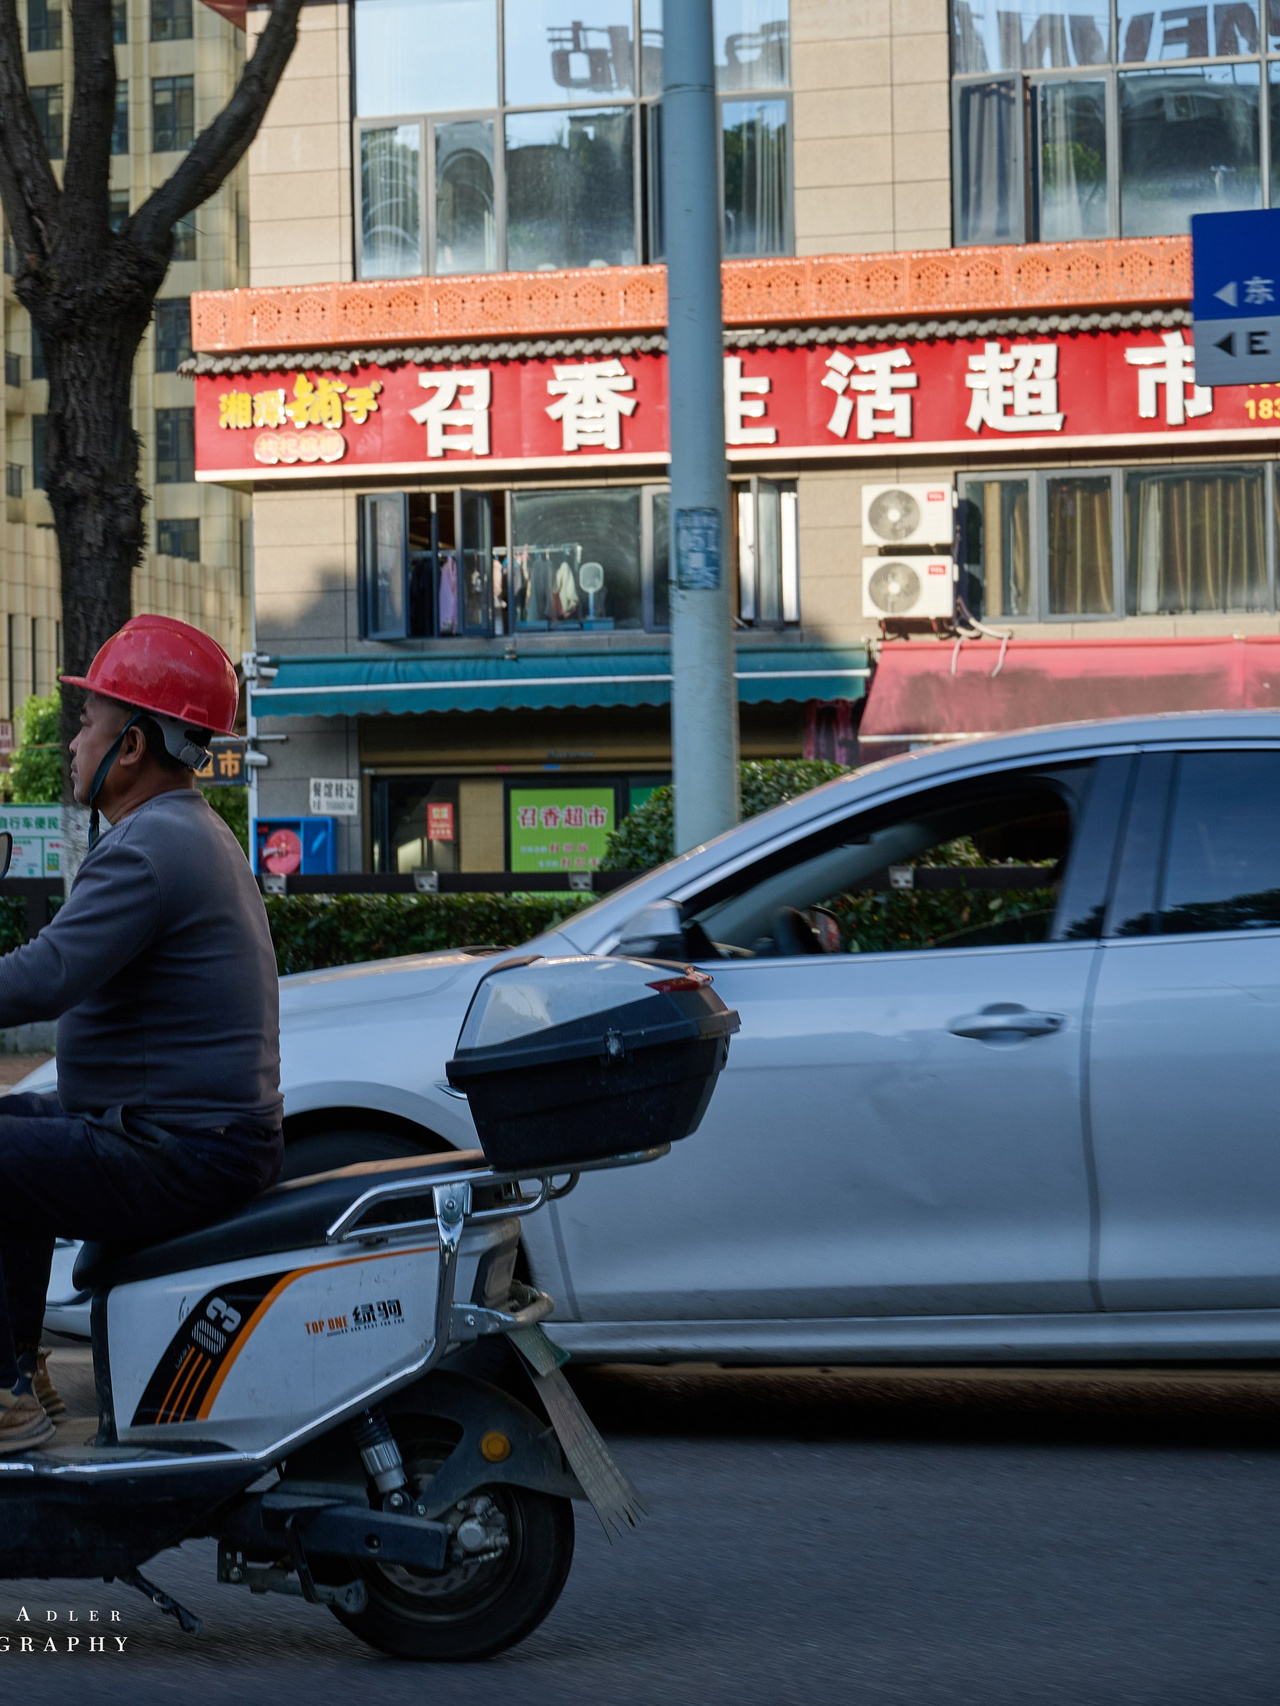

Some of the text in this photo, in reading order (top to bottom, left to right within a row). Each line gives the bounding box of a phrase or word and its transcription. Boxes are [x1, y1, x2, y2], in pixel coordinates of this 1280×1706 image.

[1246, 331, 1271, 355] E
[519, 805, 608, 828] 召香超市
[192, 1297, 241, 1355] 03
[304, 1319, 325, 1336] TOP
[327, 1315, 349, 1332] ONE
